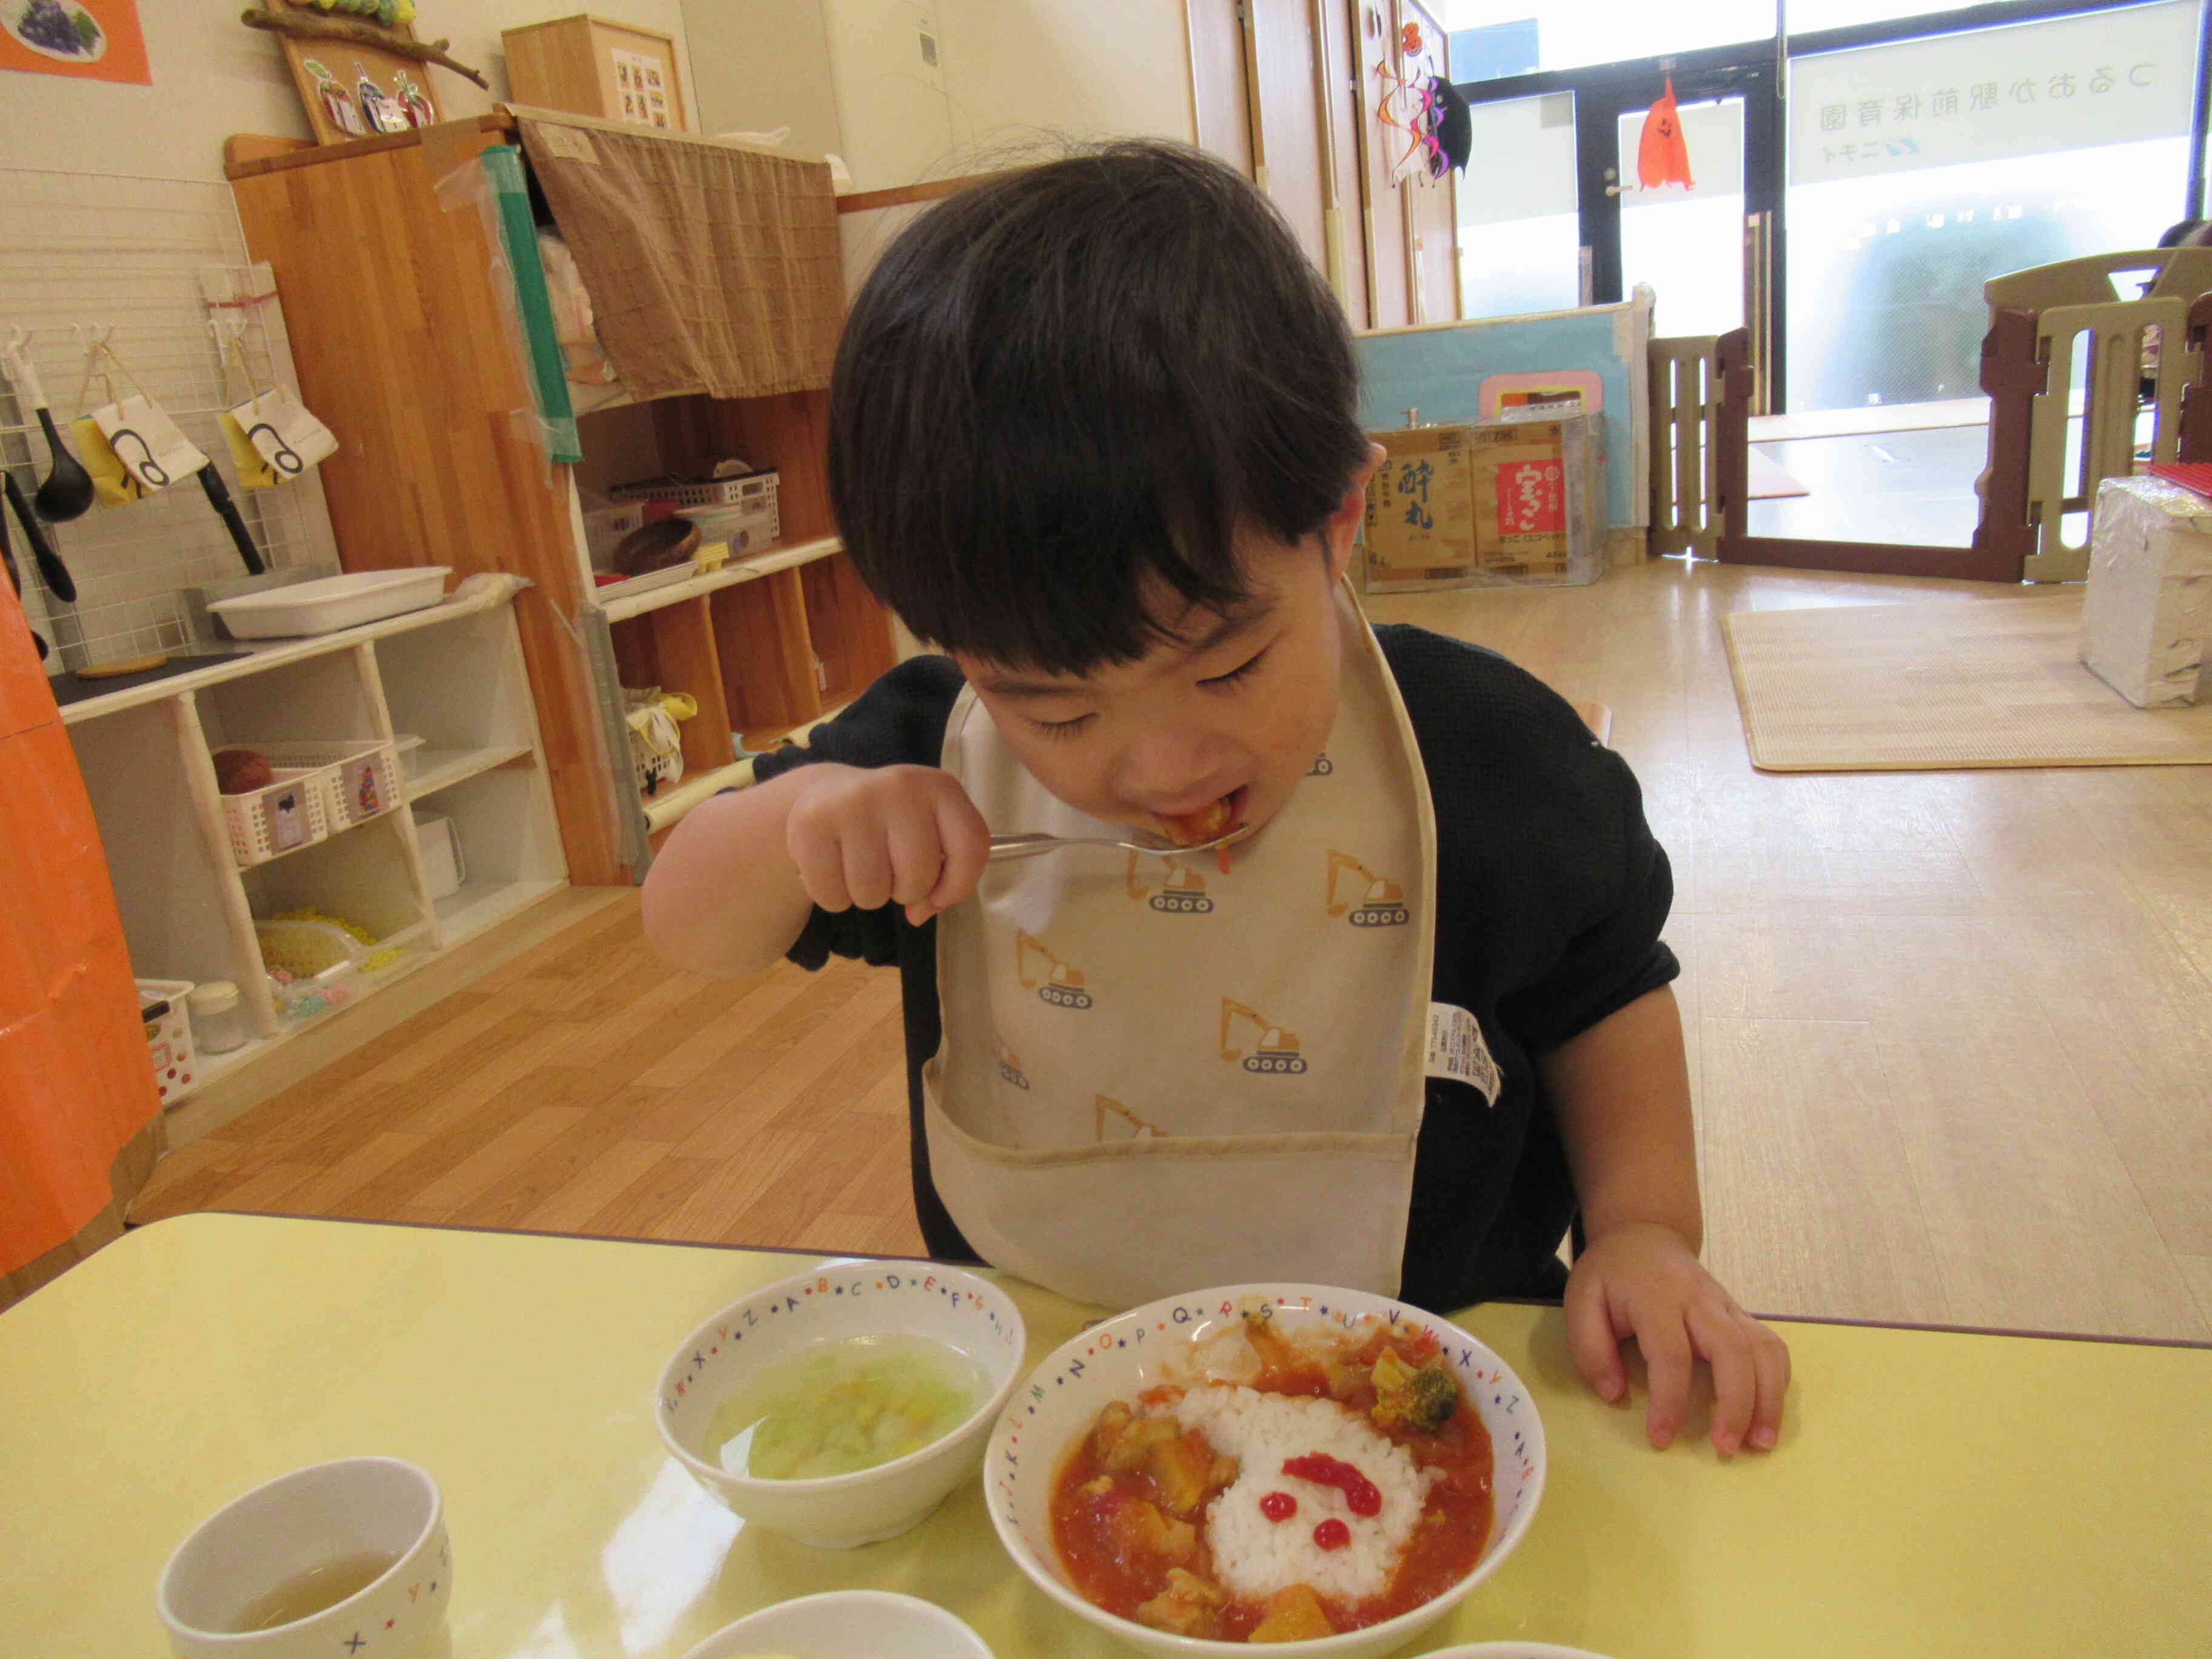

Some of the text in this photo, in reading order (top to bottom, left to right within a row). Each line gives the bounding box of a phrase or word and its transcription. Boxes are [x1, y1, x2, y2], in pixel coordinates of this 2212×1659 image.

[786, 1296, 799, 1312] A
[819, 1277, 829, 1293] B
[851, 1282, 863, 1296] C
[886, 1275, 900, 1289] D
[923, 1275, 937, 1292] E
[951, 1292, 960, 1308] F
[1099, 1333, 1113, 1349] O
[1136, 1329, 1145, 1344] P
[1172, 1307, 1193, 1324] Q
[1219, 1301, 1233, 1318] R
[1261, 1304, 1273, 1320] S
[1299, 1296, 1314, 1312] T
[1343, 1314, 1356, 1330] U
[1389, 1309, 1401, 1325] V
[1460, 1349, 1473, 1367] X
[1489, 1370, 1503, 1385] Y
[1506, 1395, 1520, 1414] Z
